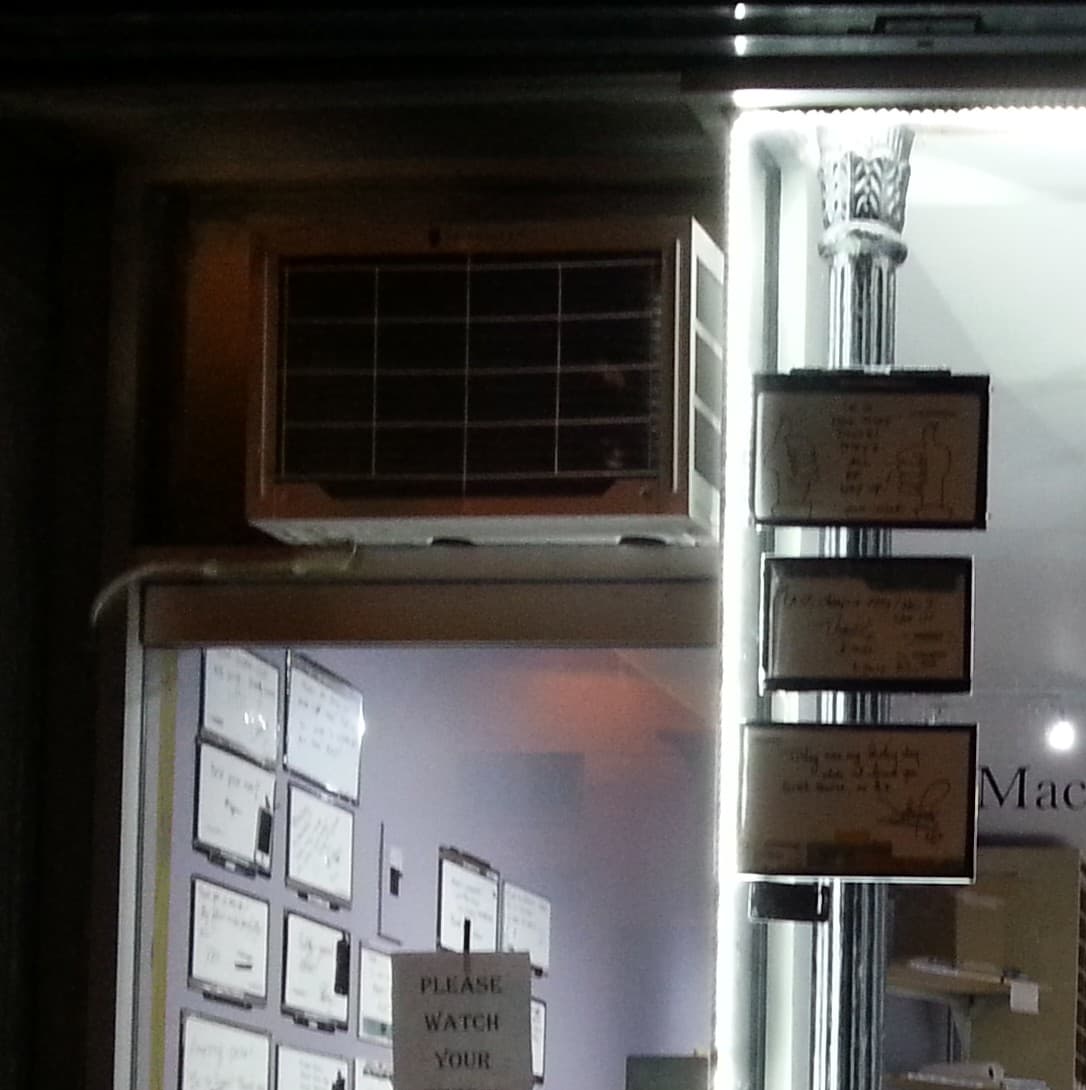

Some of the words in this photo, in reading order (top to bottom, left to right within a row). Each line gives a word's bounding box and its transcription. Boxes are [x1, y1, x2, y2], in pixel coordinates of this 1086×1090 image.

[979, 765, 1086, 811] Mac
[420, 975, 503, 995] PLEASE
[424, 1011, 499, 1032] WATCH
[434, 1050, 491, 1070] YOUR
